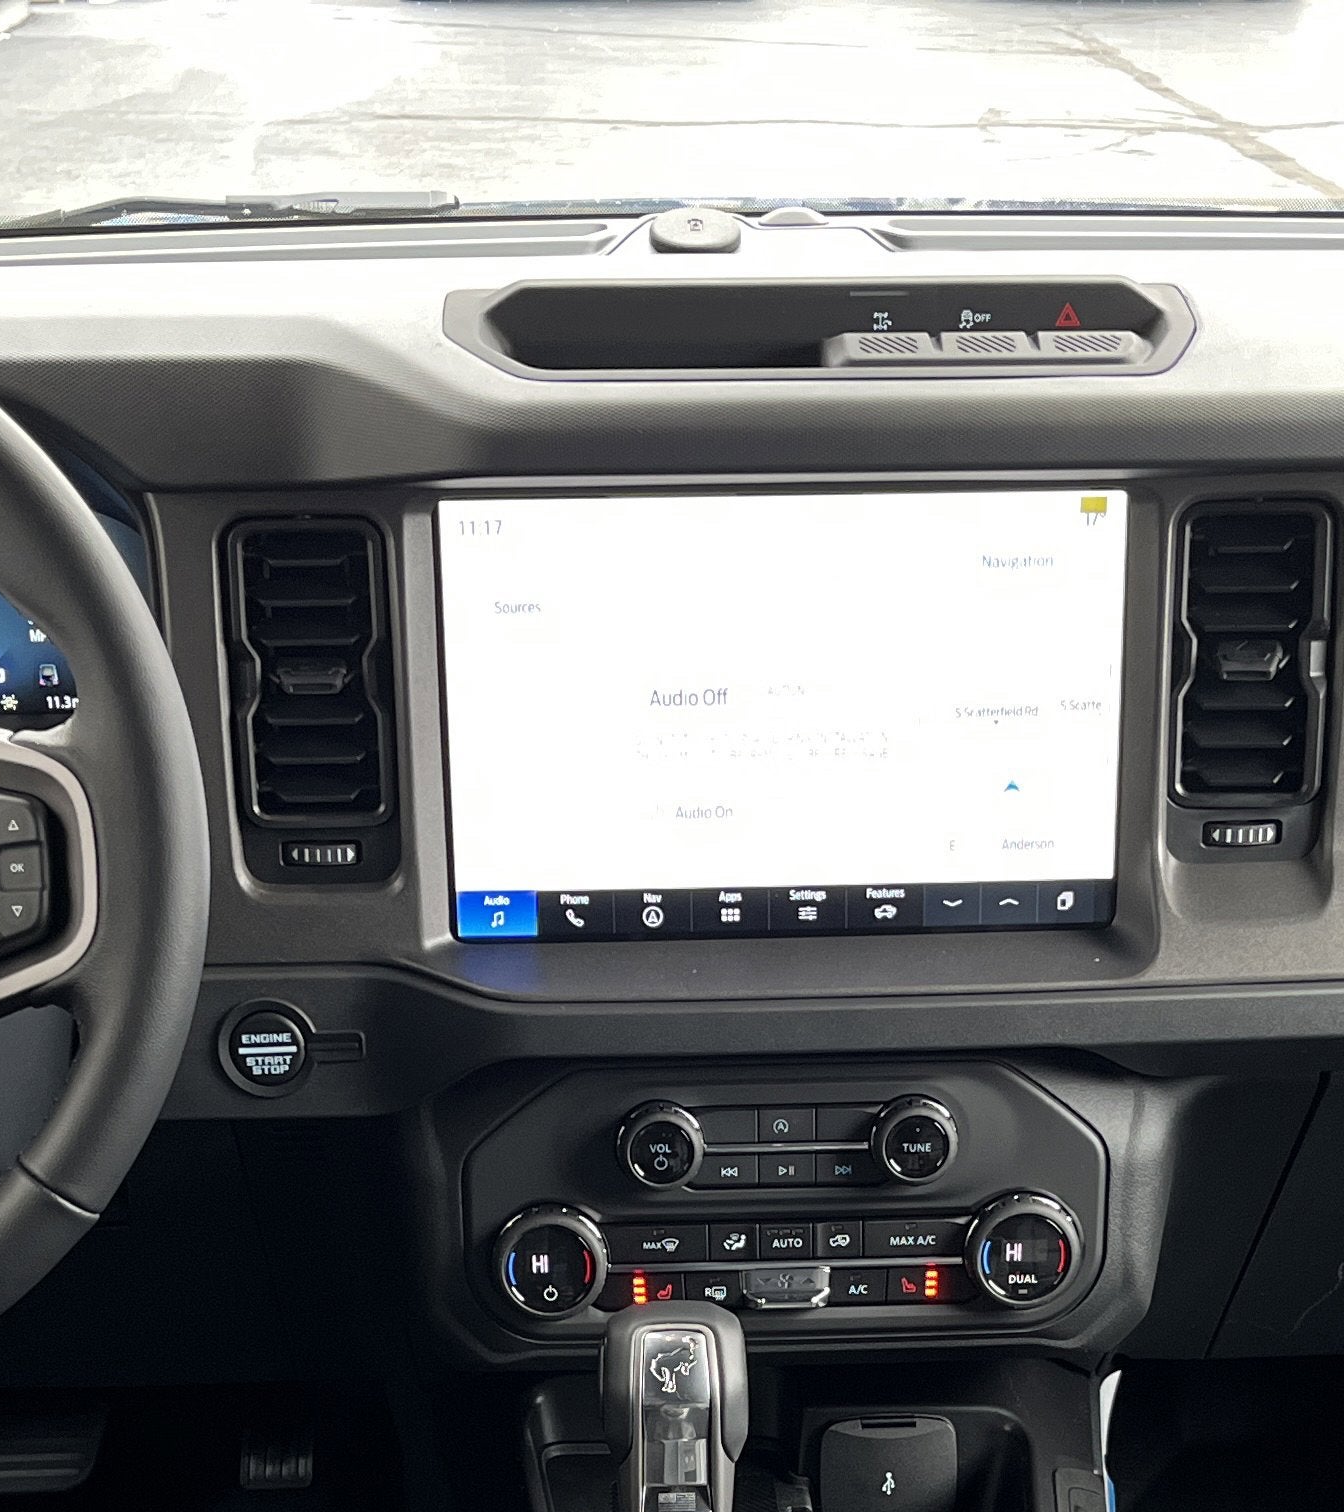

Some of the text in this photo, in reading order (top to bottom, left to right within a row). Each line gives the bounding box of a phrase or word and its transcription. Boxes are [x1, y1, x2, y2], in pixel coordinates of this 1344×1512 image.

[974, 313, 991, 323] OFF
[982, 555, 1054, 573] Navigation
[494, 601, 541, 614] Sources
[650, 687, 729, 707] Audio Off
[675, 805, 733, 819] Audio On
[1002, 838, 1055, 850] Anderson
[10, 863, 25, 873] OK
[643, 892, 662, 904] Nav
[719, 890, 742, 903] Apps
[789, 889, 827, 902] Settings
[865, 887, 905, 899] Features
[484, 895, 511, 906] Audio
[560, 894, 590, 905] Phone
[241, 1033, 292, 1044] ENGINE
[246, 1055, 293, 1067] START
[252, 1064, 289, 1075] STOP
[649, 1143, 672, 1154] VOL
[902, 1142, 932, 1153] TUNE
[642, 1241, 662, 1250] MAX
[772, 1238, 803, 1249] AUTO
[889, 1235, 937, 1247] MAX A/C
[1005, 1242, 1023, 1262] HI
[531, 1254, 549, 1274] HI
[1008, 1273, 1038, 1285] DUAL
[848, 1284, 868, 1295] A/C
